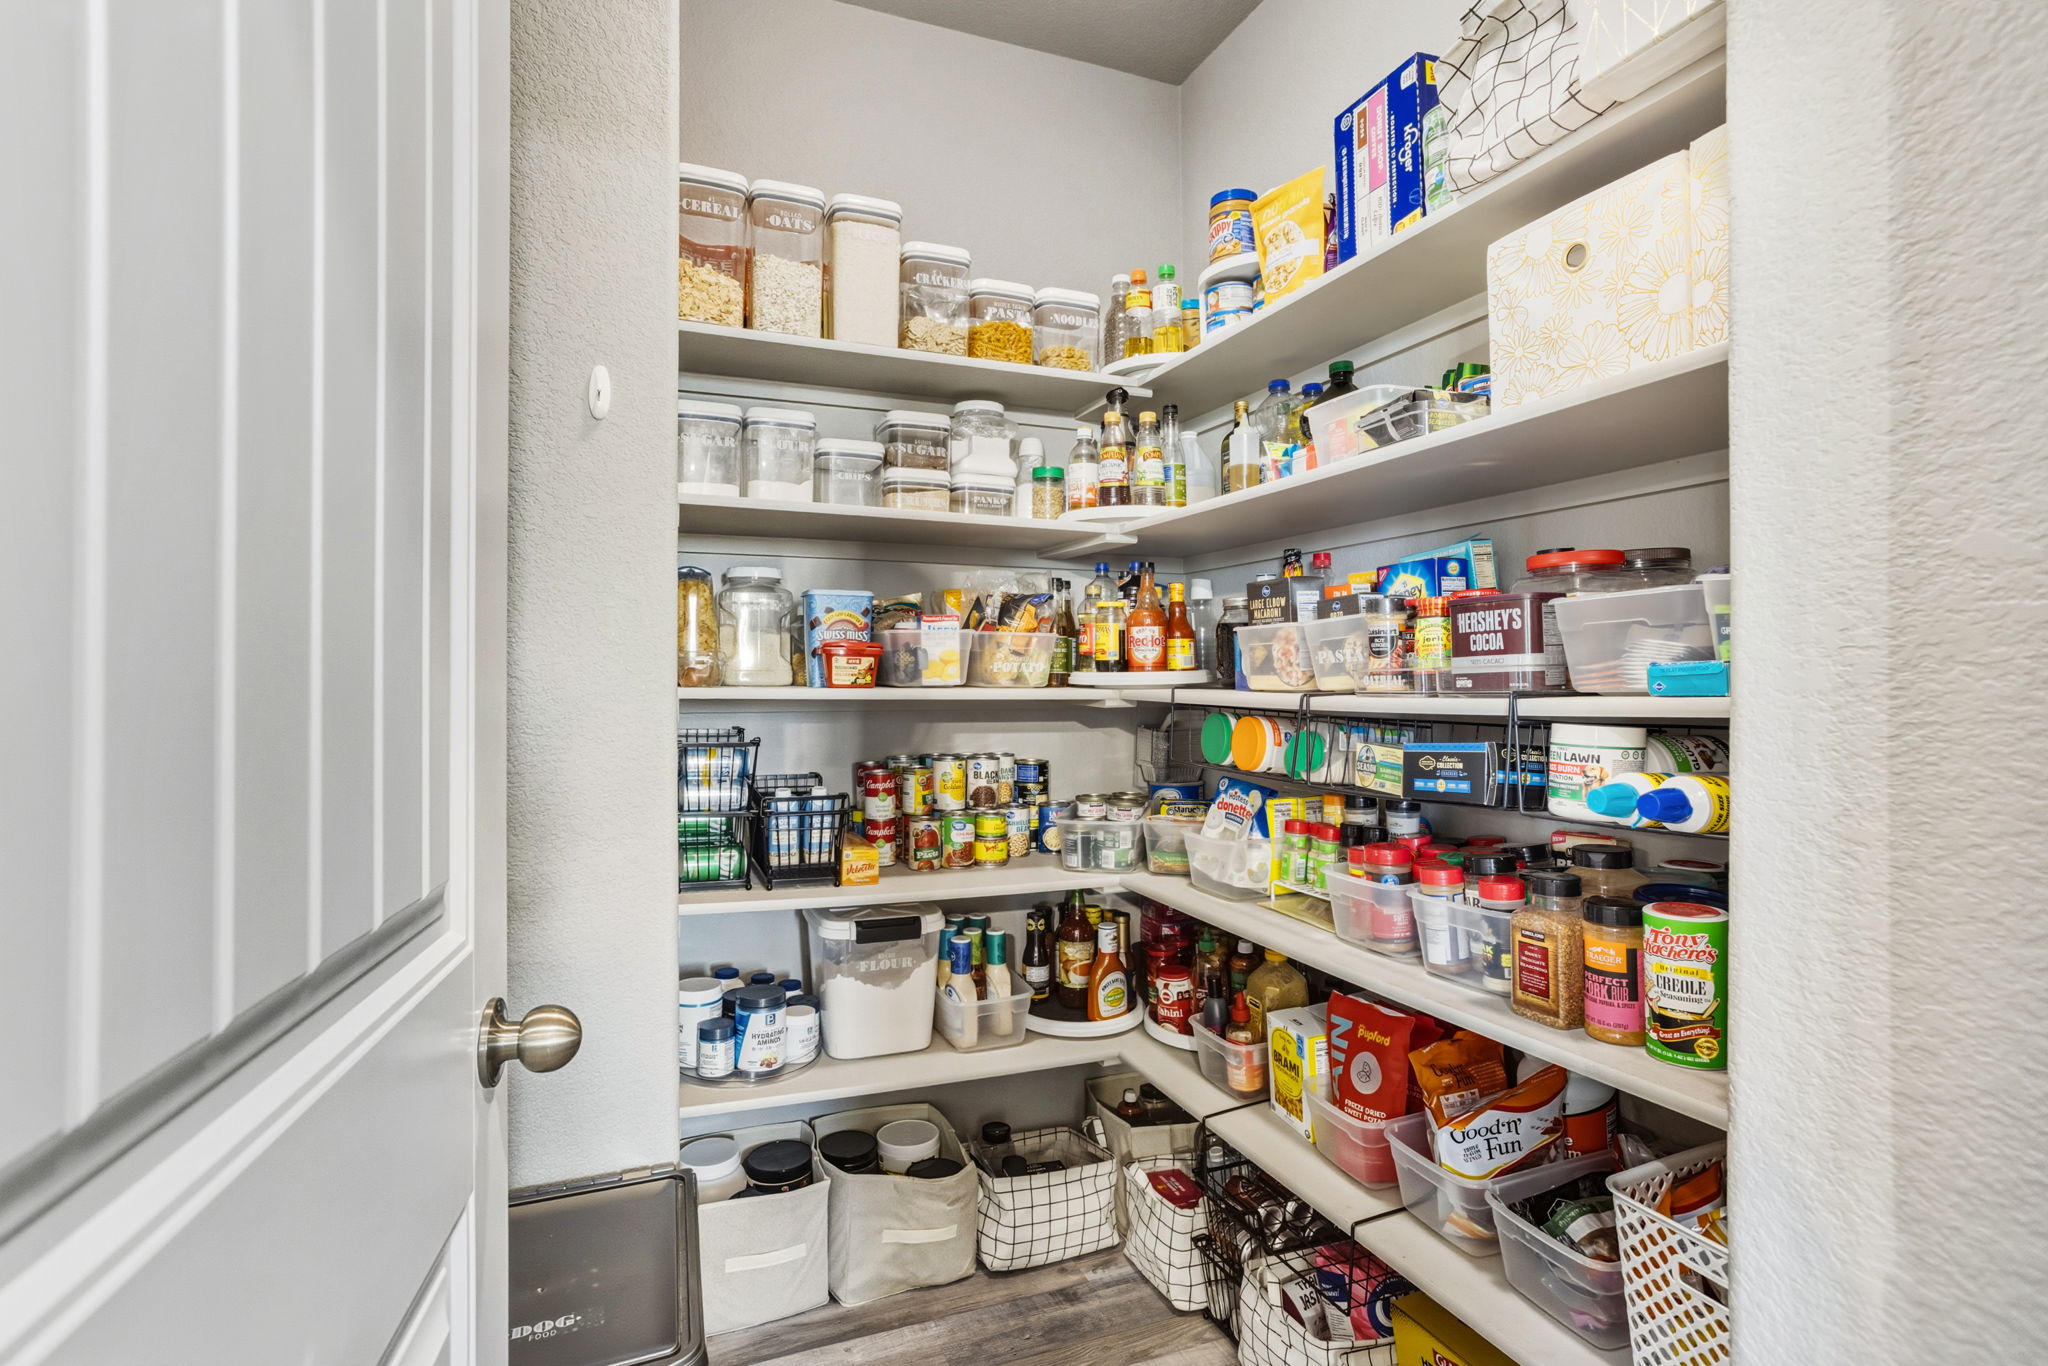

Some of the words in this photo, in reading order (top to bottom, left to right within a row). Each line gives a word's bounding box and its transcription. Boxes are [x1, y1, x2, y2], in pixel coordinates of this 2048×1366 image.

[1398, 122, 1419, 172] Kroger
[681, 197, 740, 219] CEREAL
[769, 214, 813, 231] OATS
[987, 307, 1032, 324] PASTA
[1054, 313, 1099, 329] NOODLES
[898, 444, 947, 458] SUGAR
[973, 495, 1007, 506] PANKO
[1250, 600, 1265, 610] LARGE
[1266, 596, 1286, 608] ELBOW
[1253, 608, 1281, 619] MACARONI
[1457, 608, 1522, 634] HERSHEY'S
[817, 630, 846, 641] SWISS
[1470, 632, 1504, 652] COCOA
[1318, 650, 1366, 665] PASTA
[1563, 752, 1600, 764] LAWN
[1356, 761, 1377, 773] SEASON
[1436, 762, 1463, 770] COLLECTION
[1558, 764, 1580, 774] BURN
[974, 771, 1000, 780] BLACK
[1229, 792, 1249, 805] Hostess
[1714, 794, 1725, 810] SIZE
[1650, 928, 1707, 948] Tony
[1586, 951, 1622, 964] TRAEGER
[1643, 938, 1719, 963] hachere's
[858, 957, 913, 972] FLOUR
[1659, 964, 1700, 976] Original
[1585, 971, 1629, 986] PERFECT
[1656, 974, 1707, 996] CREOLE
[1585, 979, 1610, 1000] PORK
[1611, 986, 1629, 1001] RUB
[1660, 990, 1704, 1005] Seasoning
[1358, 1024, 1391, 1046] pupford
[1658, 1030, 1672, 1039] Great
[1680, 1026, 1711, 1037] Everything!
[757, 1037, 782, 1046] AMINOS
[1273, 1050, 1300, 1078] BRAMI
[1344, 1098, 1365, 1112] FREEZE
[1364, 1107, 1387, 1119] DRIED
[1344, 1106, 1363, 1119] SWEET
[1484, 1137, 1523, 1160] Fun
[510, 1314, 575, 1340] DOG
[528, 1329, 557, 1342] FOOD
